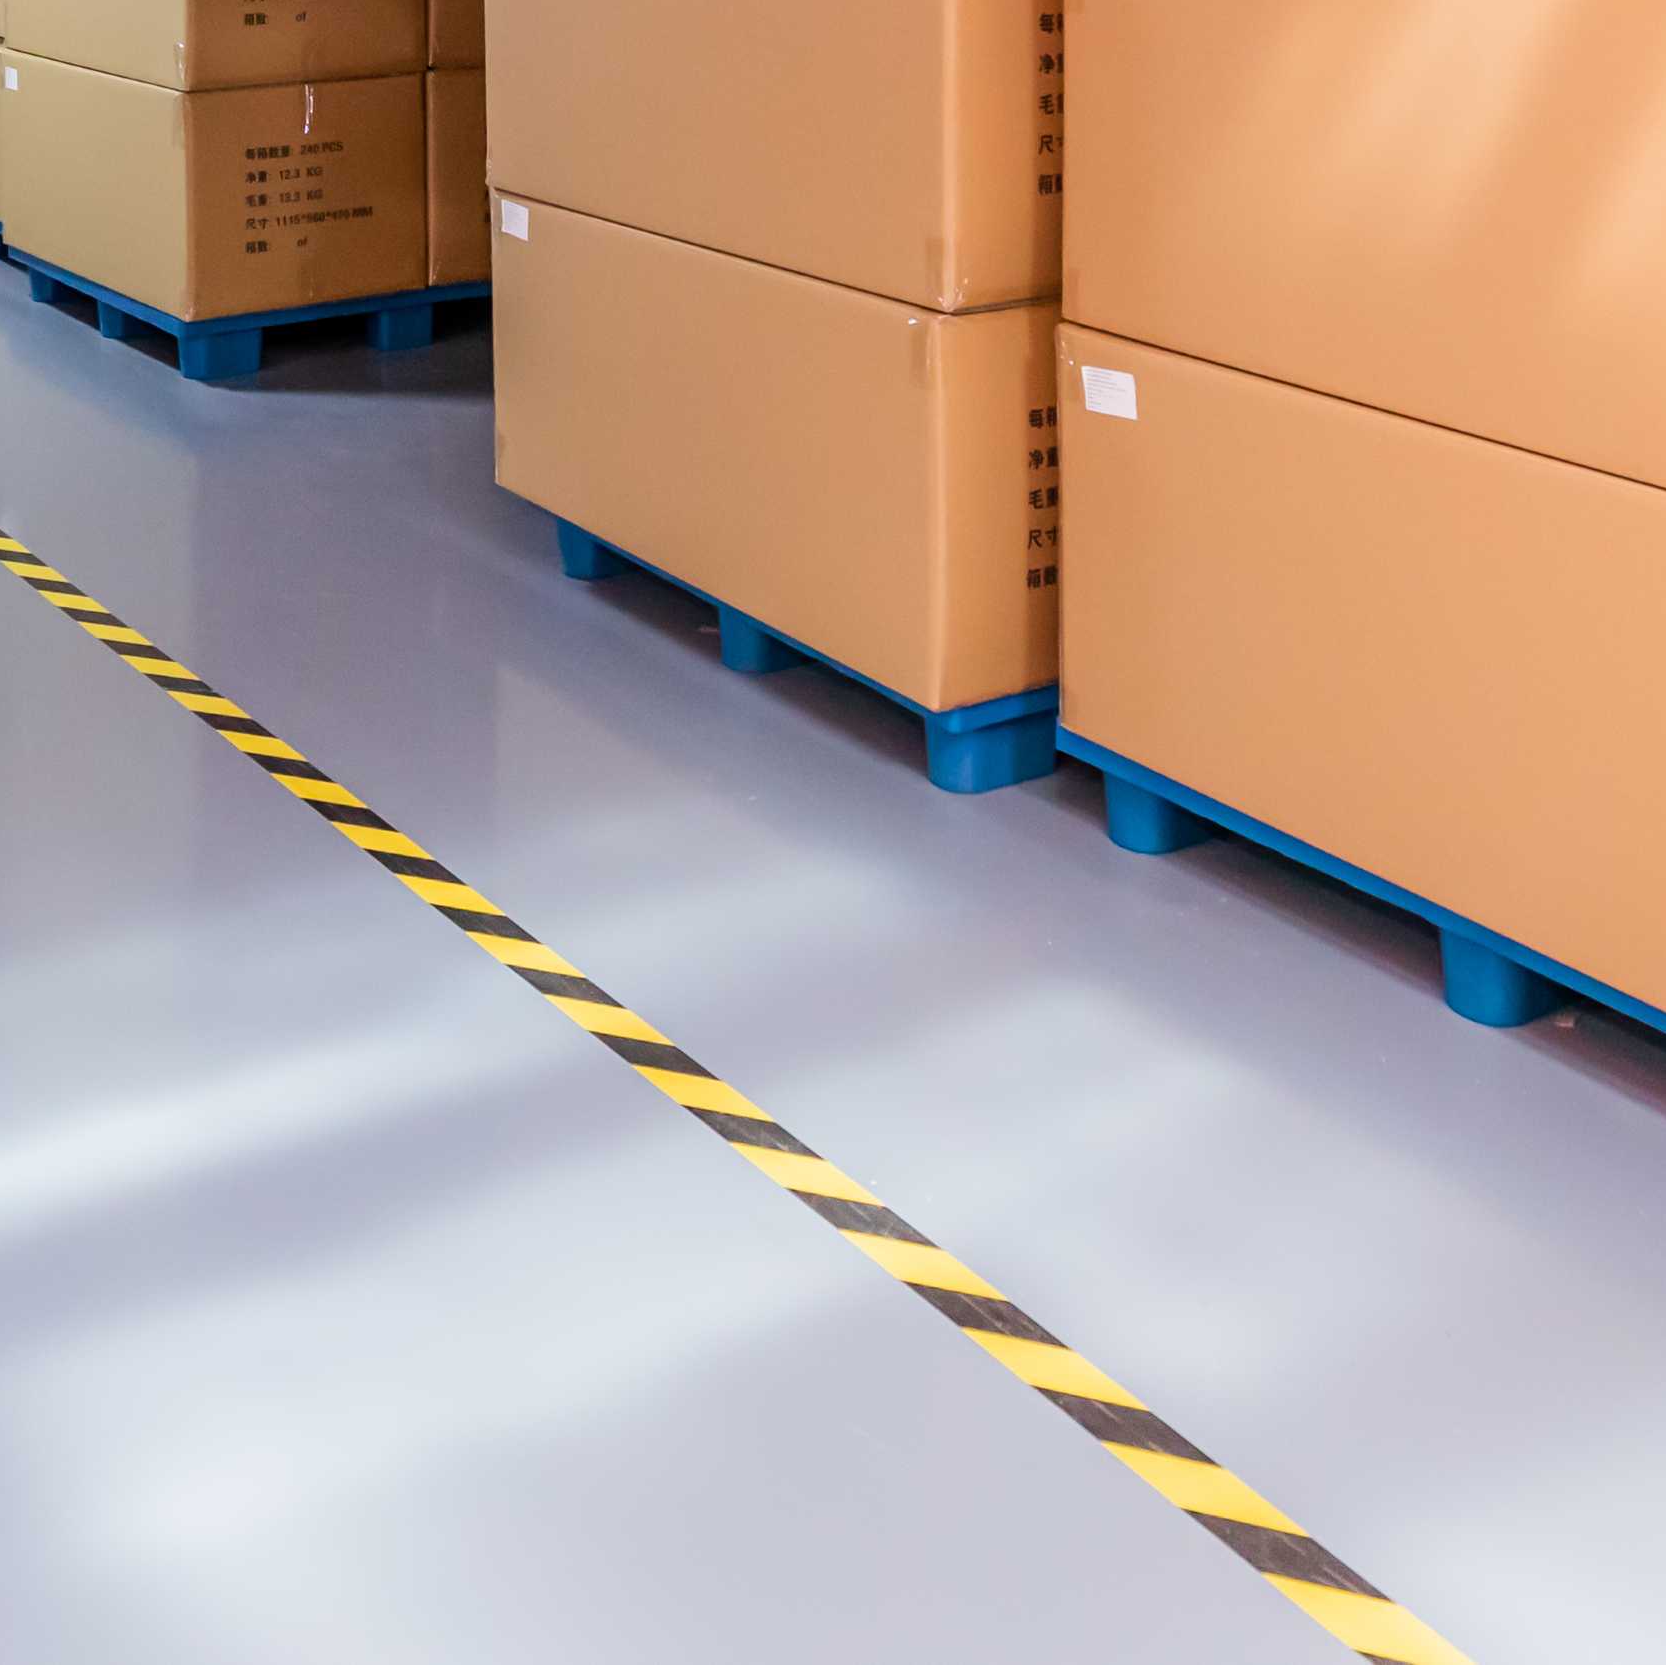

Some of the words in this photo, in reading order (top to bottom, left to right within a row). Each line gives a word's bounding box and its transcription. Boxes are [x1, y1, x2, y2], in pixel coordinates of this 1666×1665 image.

[295, 12, 306, 22] of
[322, 141, 343, 153] PCS
[306, 166, 323, 177] KG
[307, 189, 323, 201] KG
[297, 237, 308, 248] of
[1027, 529, 1058, 549] 尺寸
